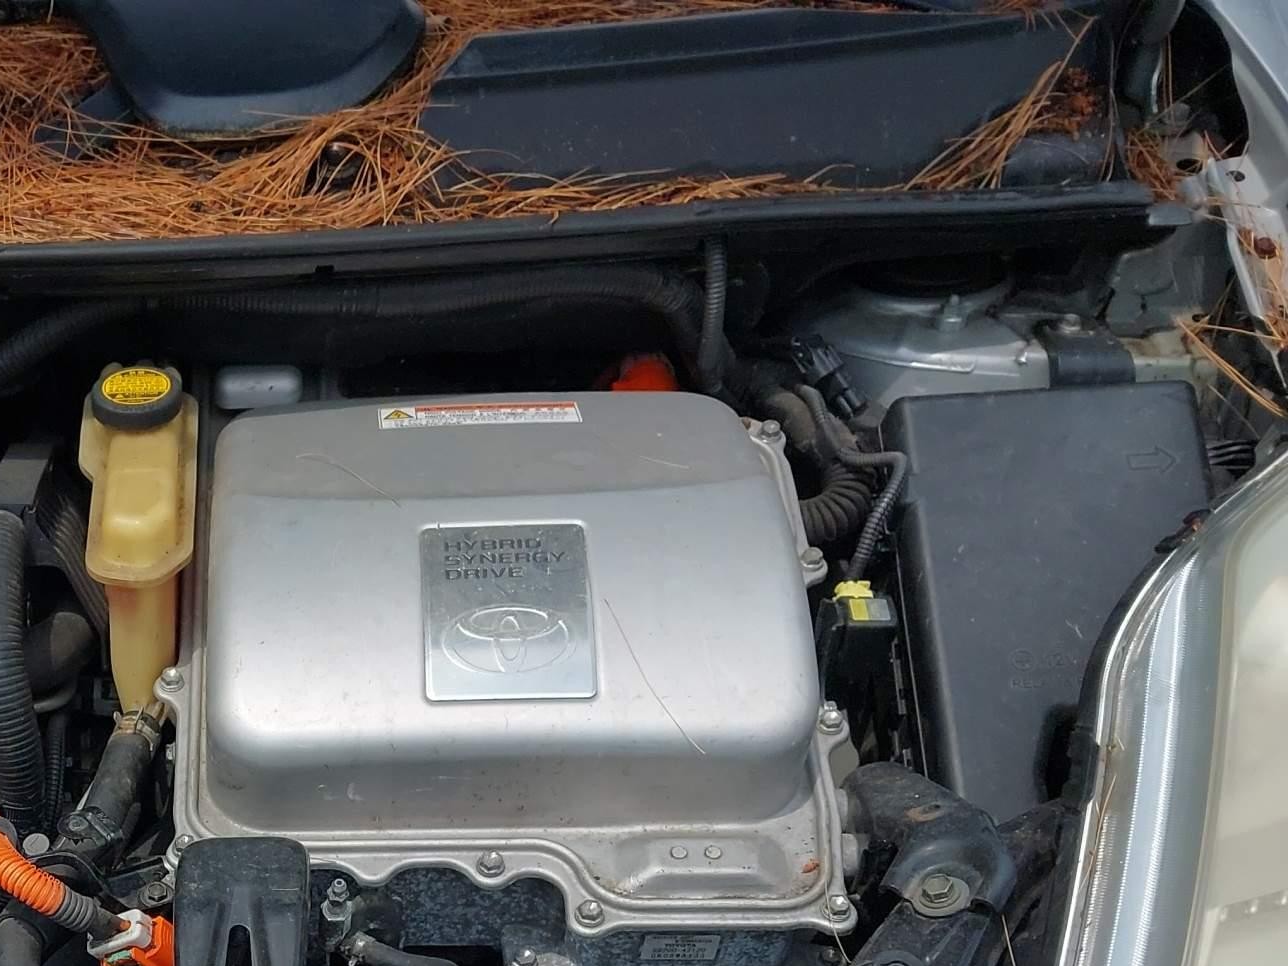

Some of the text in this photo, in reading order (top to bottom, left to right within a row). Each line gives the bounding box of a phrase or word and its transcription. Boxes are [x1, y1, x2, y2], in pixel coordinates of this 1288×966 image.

[442, 537, 542, 552] HYBRID
[443, 551, 566, 566] SYNERGY
[445, 566, 524, 581] DRIVE
